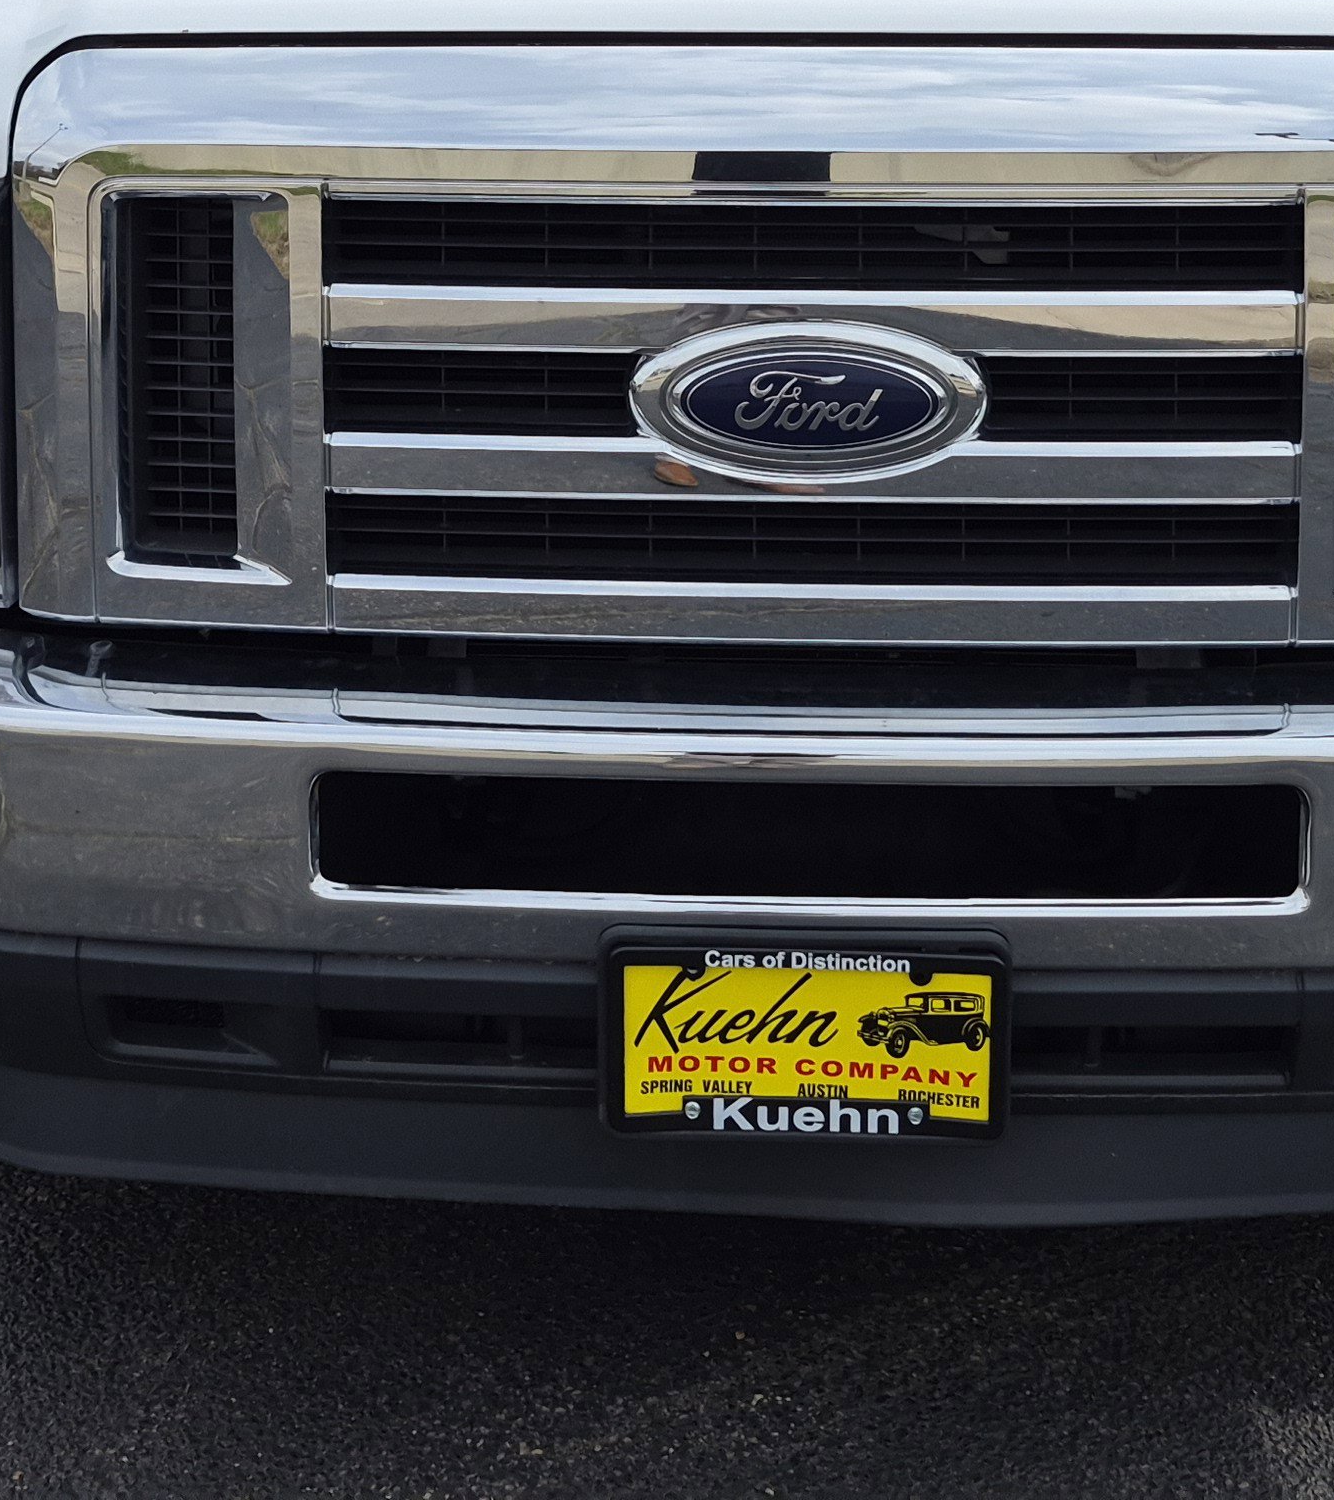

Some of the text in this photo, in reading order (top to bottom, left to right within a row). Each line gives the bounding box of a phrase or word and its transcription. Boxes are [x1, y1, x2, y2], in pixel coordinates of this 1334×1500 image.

[734, 371, 884, 431] Ford
[704, 950, 911, 973] Cars of Distinction
[634, 970, 839, 1053] Kuehn
[647, 1055, 979, 1088] MOTOR COMPANY
[640, 1079, 753, 1095] SPRING VALLEY
[797, 1083, 849, 1099] AUSTIN
[897, 1088, 981, 1109] ROCHESTER
[712, 1097, 900, 1134] Kuehn
